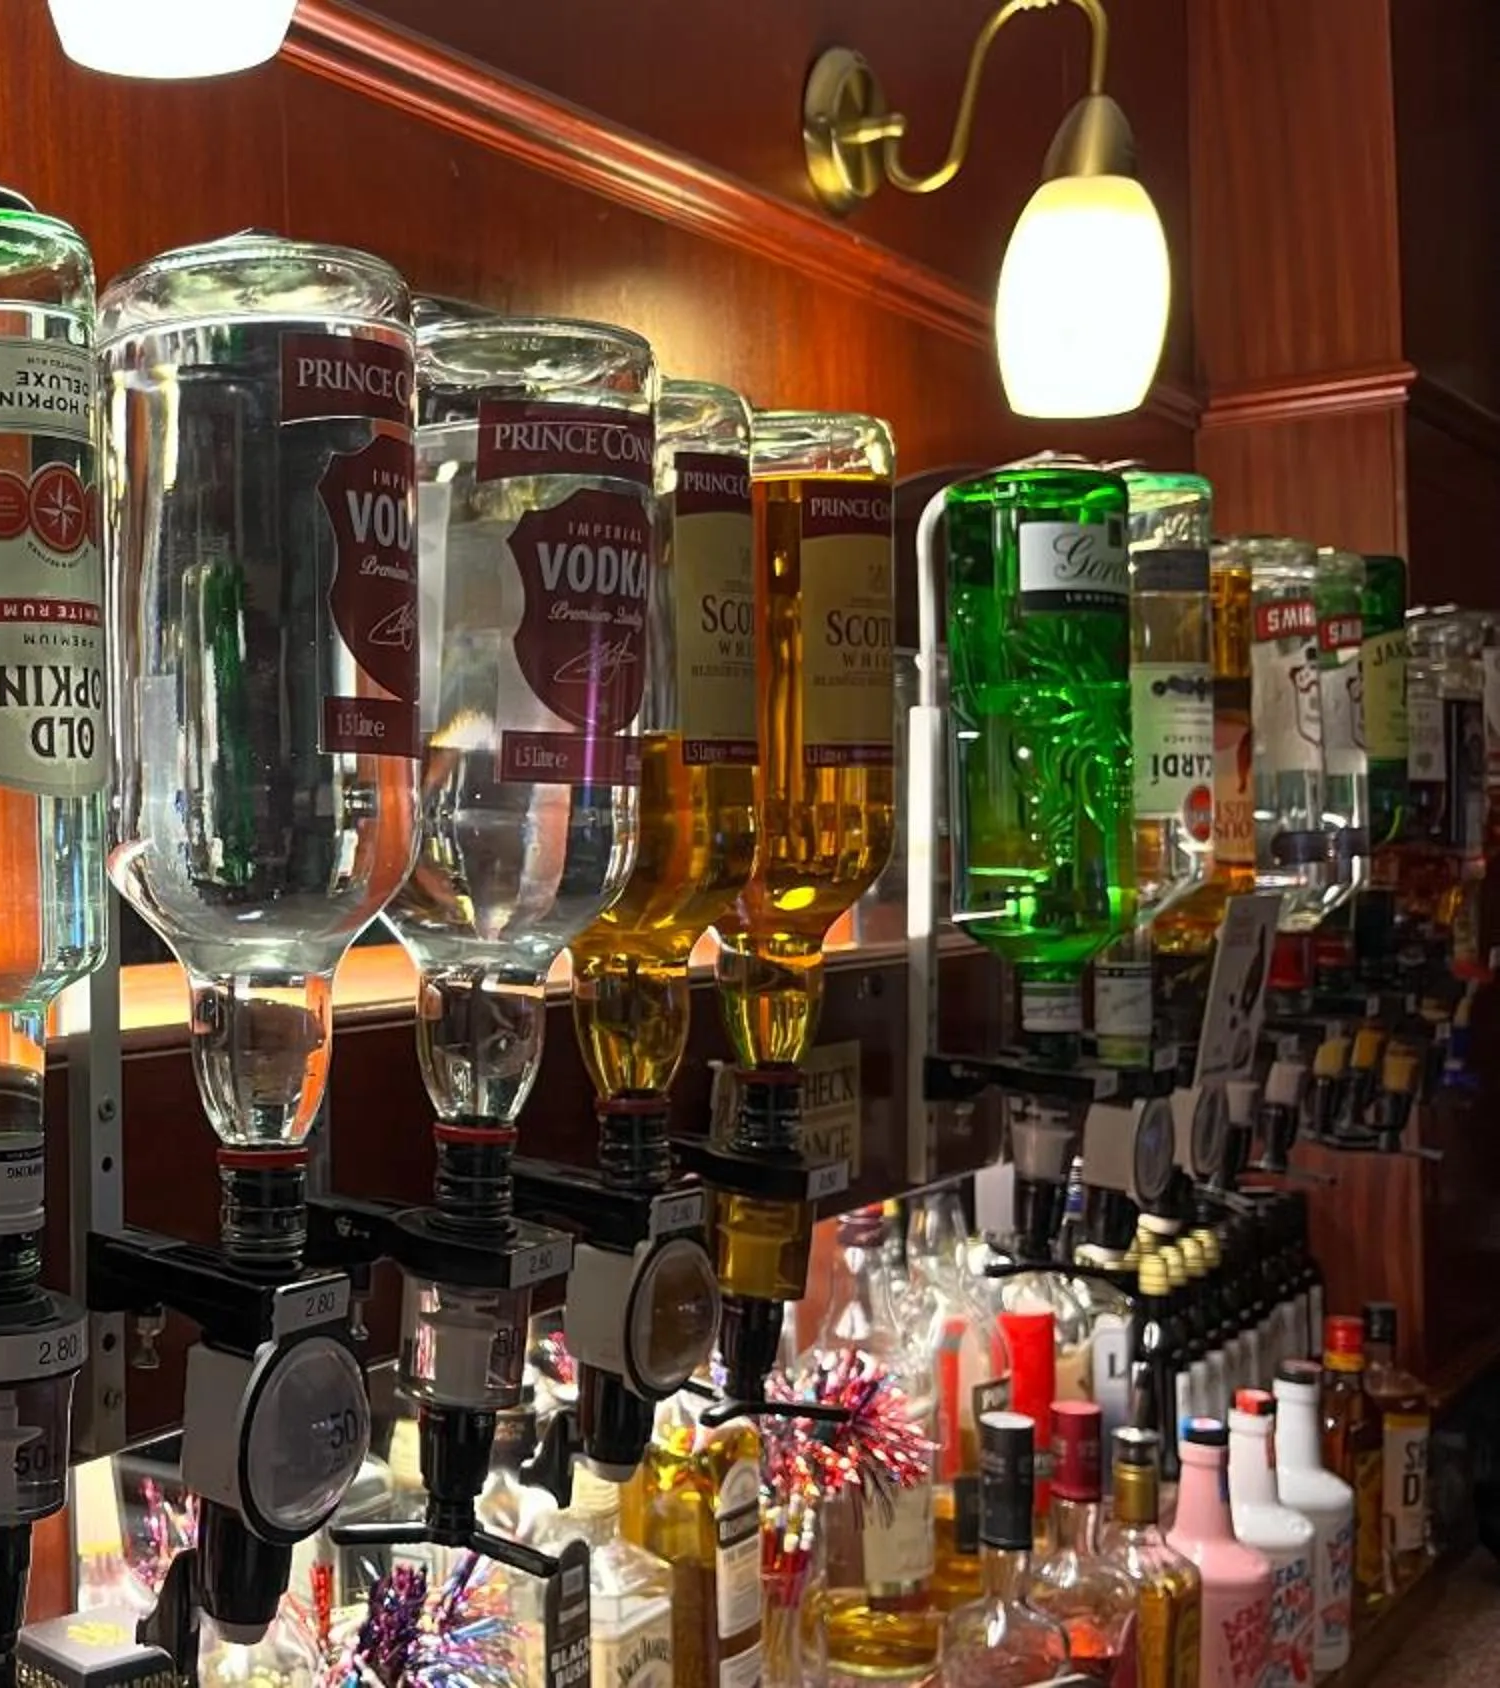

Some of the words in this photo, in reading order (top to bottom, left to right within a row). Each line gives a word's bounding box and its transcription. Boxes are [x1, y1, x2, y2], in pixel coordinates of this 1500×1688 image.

[15, 370, 89, 398] DELUXE
[298, 358, 393, 401] PRINCE
[494, 423, 598, 455] PRINCE
[601, 425, 652, 463] CONS
[684, 471, 738, 496] PRINCE
[347, 490, 412, 552] VOD
[811, 497, 870, 519] PRINCE
[568, 521, 642, 546] IMPERIAL
[536, 541, 648, 598] VODKA
[3, 602, 50, 617] RUM
[701, 594, 755, 636] SCO
[23, 633, 94, 648] PREMIUM
[826, 609, 892, 648] SCOT
[30, 716, 95, 759] OLD
[305, 1292, 336, 1318] 2.80
[38, 1334, 78, 1366] 2.80
[329, 1408, 359, 1451] 50
[13, 1444, 48, 1476] 50
